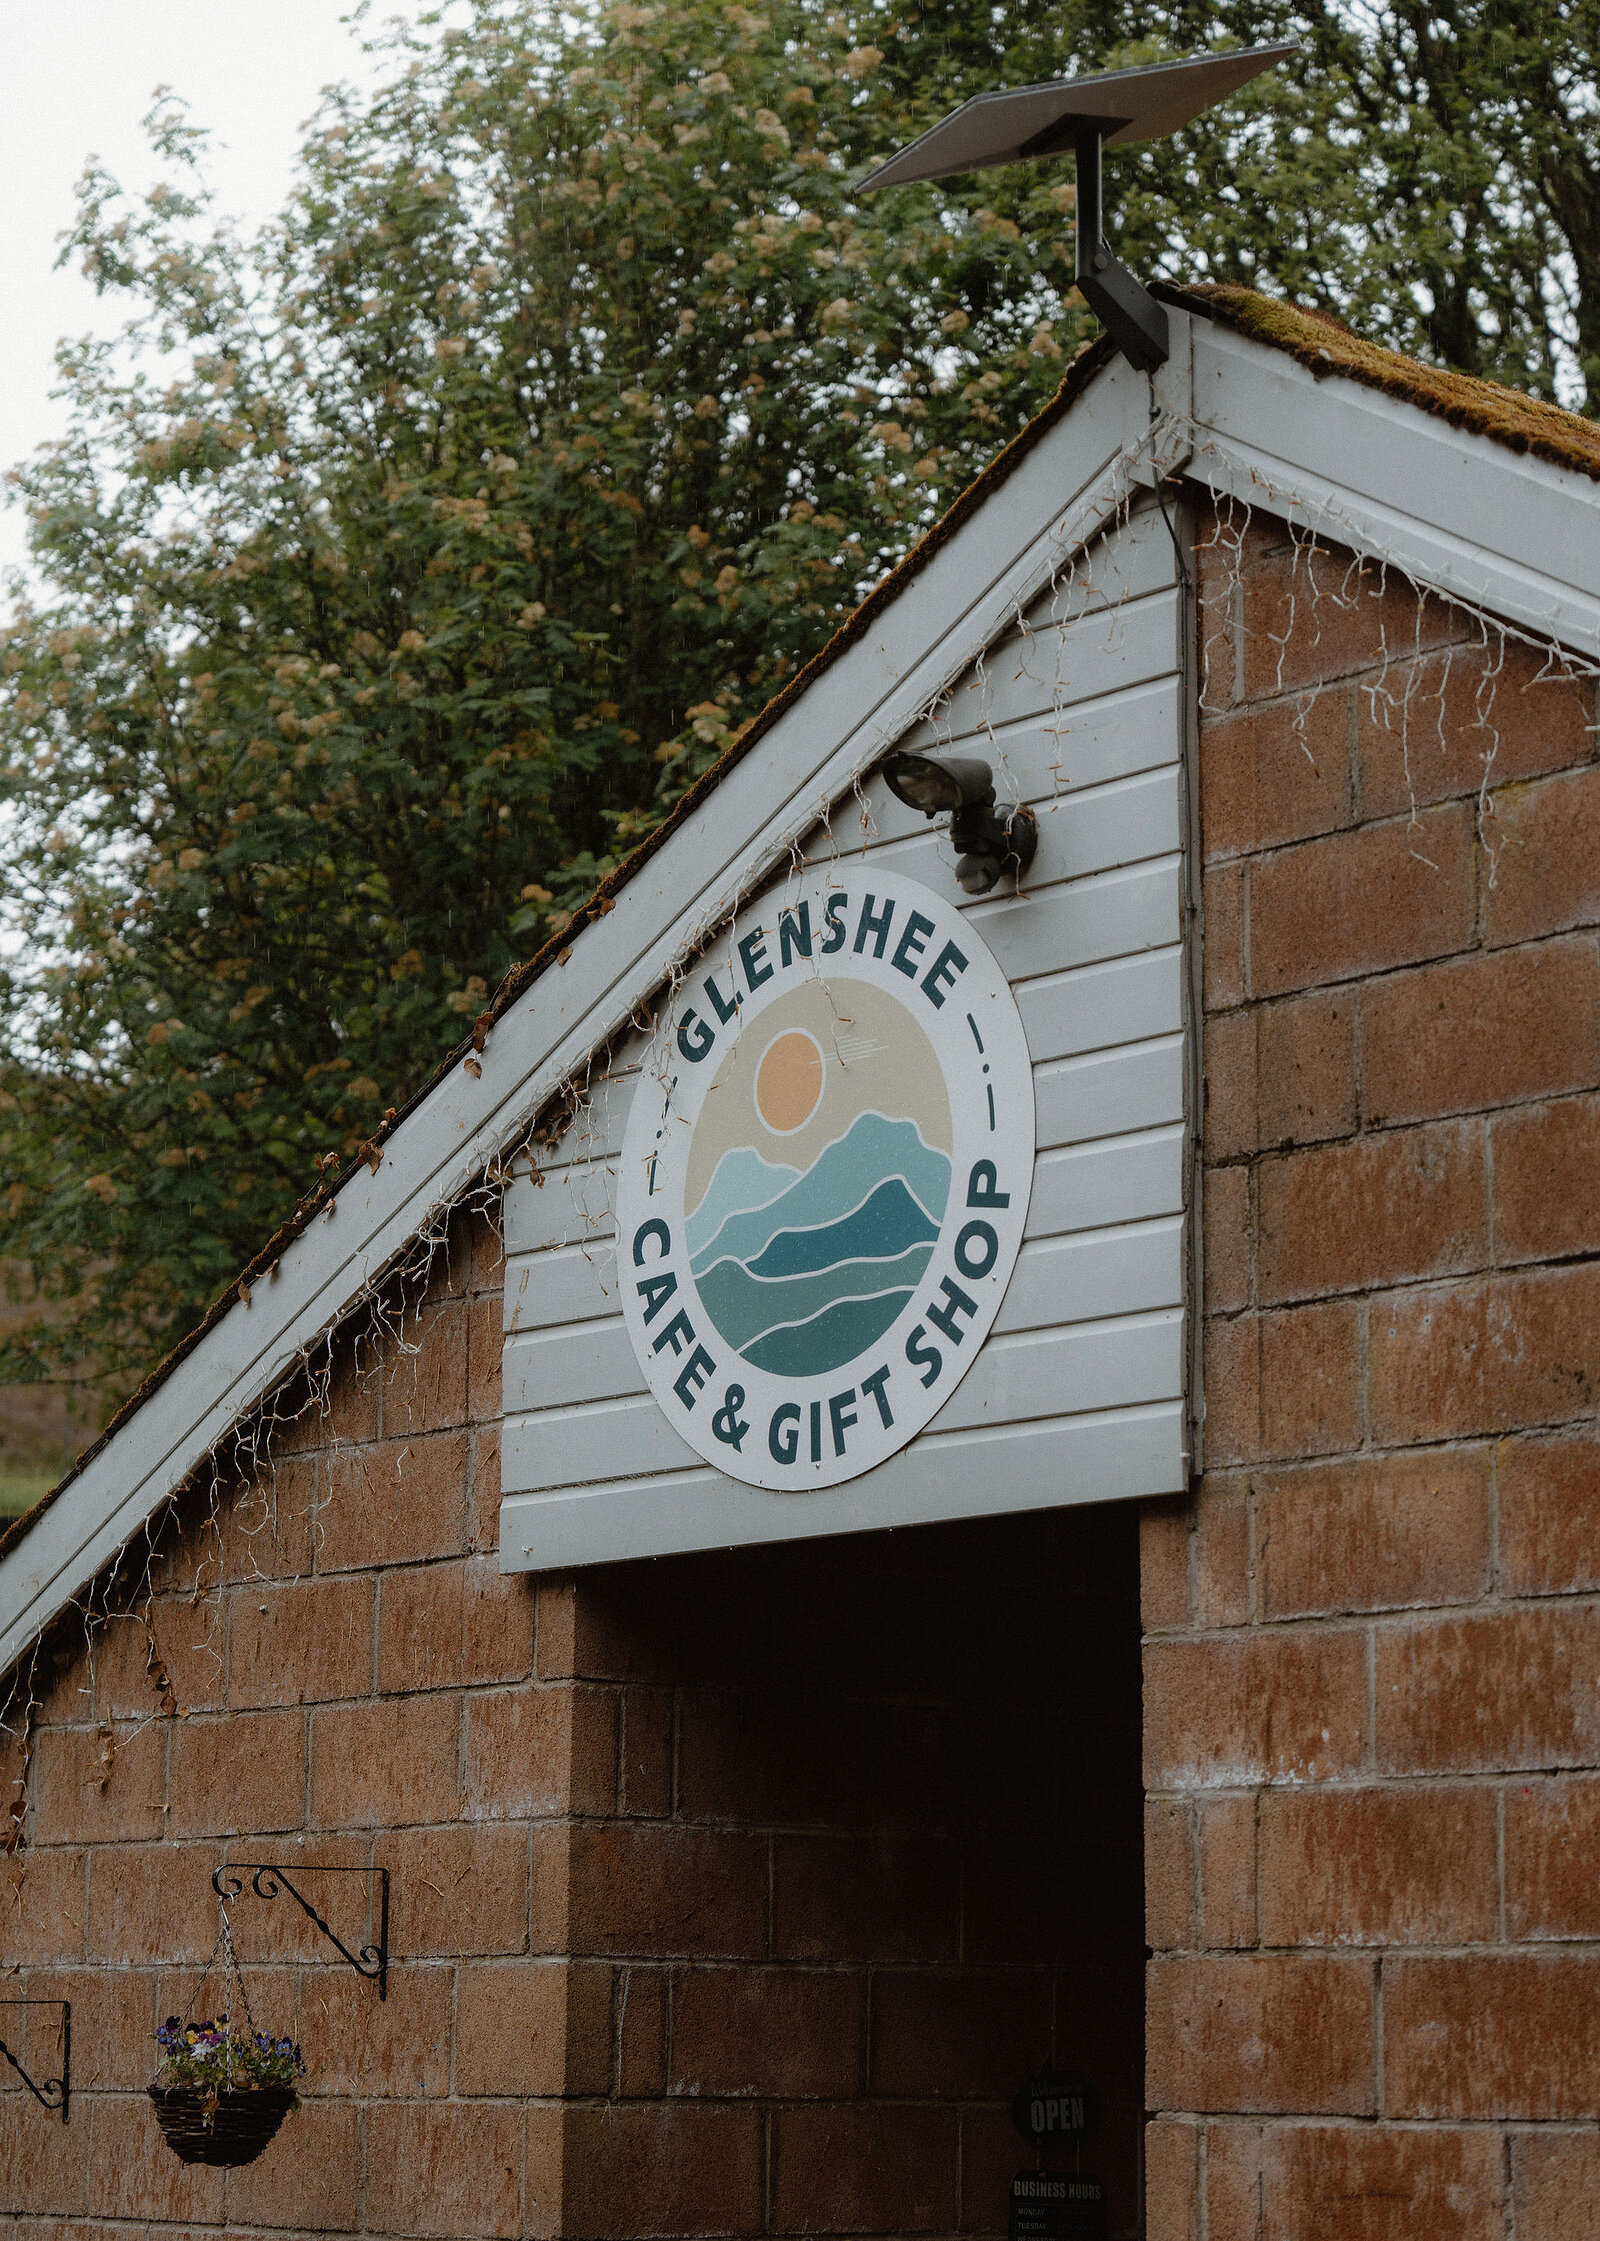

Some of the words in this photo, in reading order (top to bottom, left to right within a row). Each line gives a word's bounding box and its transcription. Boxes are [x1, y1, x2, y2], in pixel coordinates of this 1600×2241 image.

[675, 892, 970, 1063] GLENSHEE
[632, 1217, 718, 1412] CAFE
[711, 1383, 751, 1454] &
[768, 1363, 896, 1466] GIFT
[904, 1158, 1012, 1390] SHOP
[1031, 2097, 1085, 2133] OPEN
[1014, 2180, 1066, 2198] BUSINESS
[1068, 2183, 1101, 2200] HOURS
[1018, 2207, 1046, 2216] MONDAY
[1017, 2222, 1048, 2231] TUESDAY
